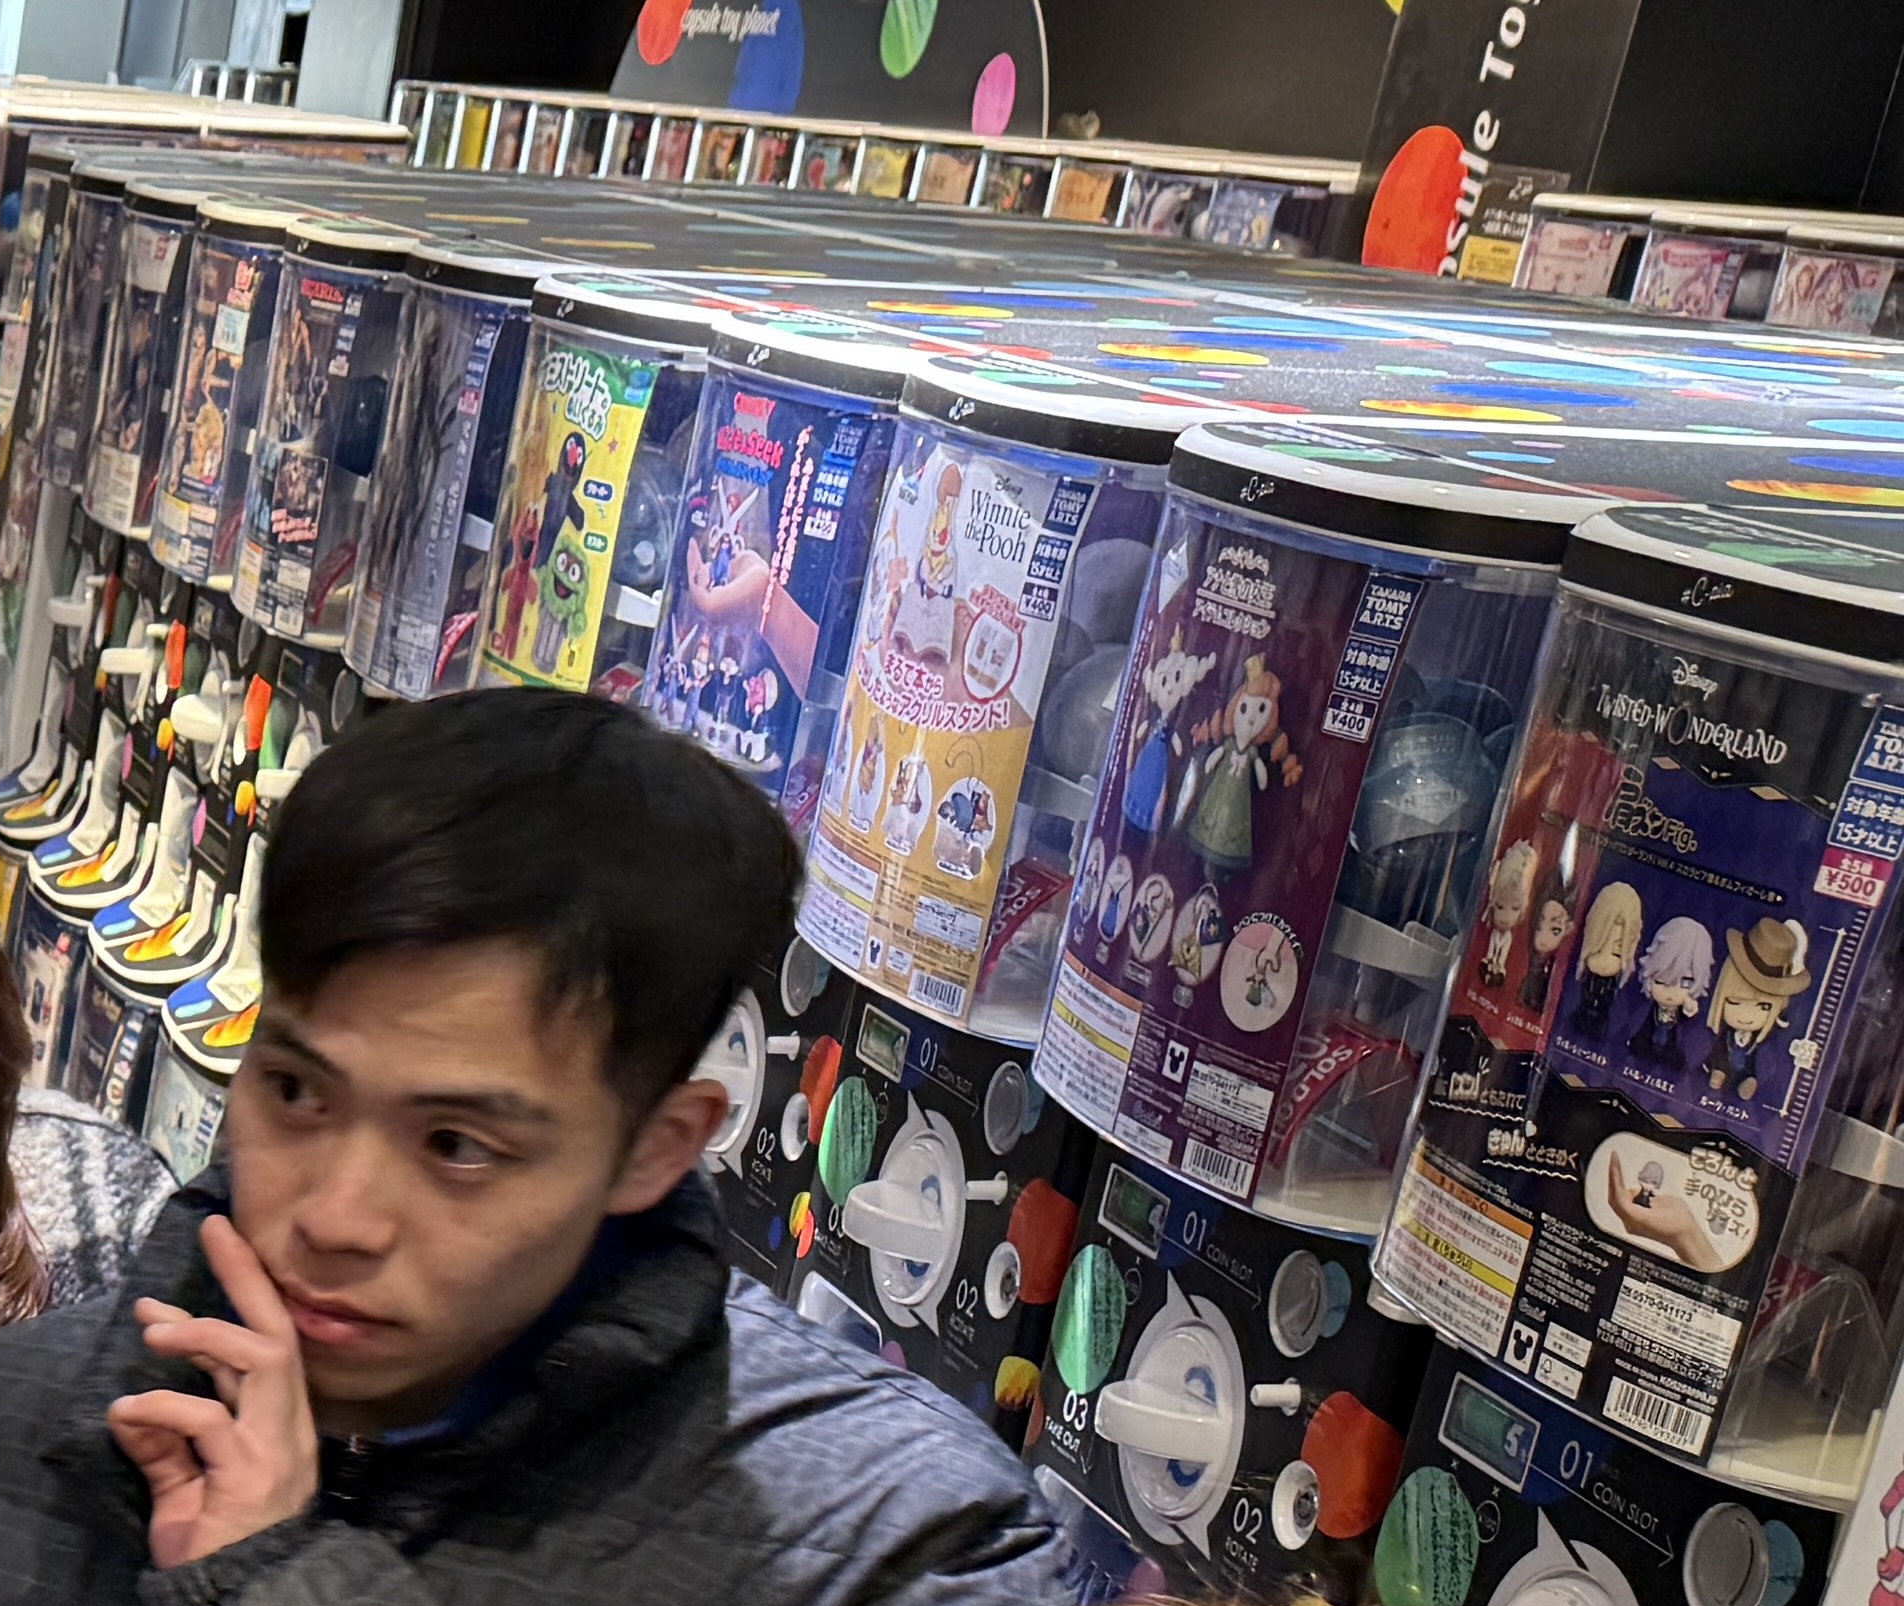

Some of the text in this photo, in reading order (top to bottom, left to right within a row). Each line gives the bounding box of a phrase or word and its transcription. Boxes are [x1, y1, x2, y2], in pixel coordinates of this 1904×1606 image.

[681, 3, 781, 43] capsule toy planet
[970, 488, 1031, 530] Winnie
[1048, 511, 1079, 527] ARTS
[1053, 498, 1084, 513] TOMY
[964, 517, 1026, 564] the Pooh
[1025, 596, 1052, 614] ¥400
[1359, 610, 1404, 631] ARTS
[1365, 596, 1409, 616] TOMY
[1671, 656, 1719, 702] Disney
[1330, 710, 1366, 732] ¥400
[1837, 822, 1899, 852] 15才以上
[1824, 869, 1878, 898] ¥500
[919, 1036, 938, 1071] 01
[1292, 1044, 1353, 1103] SOLD
[757, 1125, 776, 1161] 02
[1688, 1146, 1760, 1191] ころんと
[1182, 1209, 1209, 1248] 01
[1206, 1243, 1254, 1282] COIN SLOT
[955, 1279, 980, 1317] 02
[1061, 1387, 1090, 1432] 03
[1504, 1423, 1525, 1458] 5
[1559, 1439, 1593, 1489] 01
[1232, 1498, 1264, 1545] 02
[1592, 1481, 1660, 1536] COIN SLOT
[1225, 1535, 1259, 1573] ROTATE
